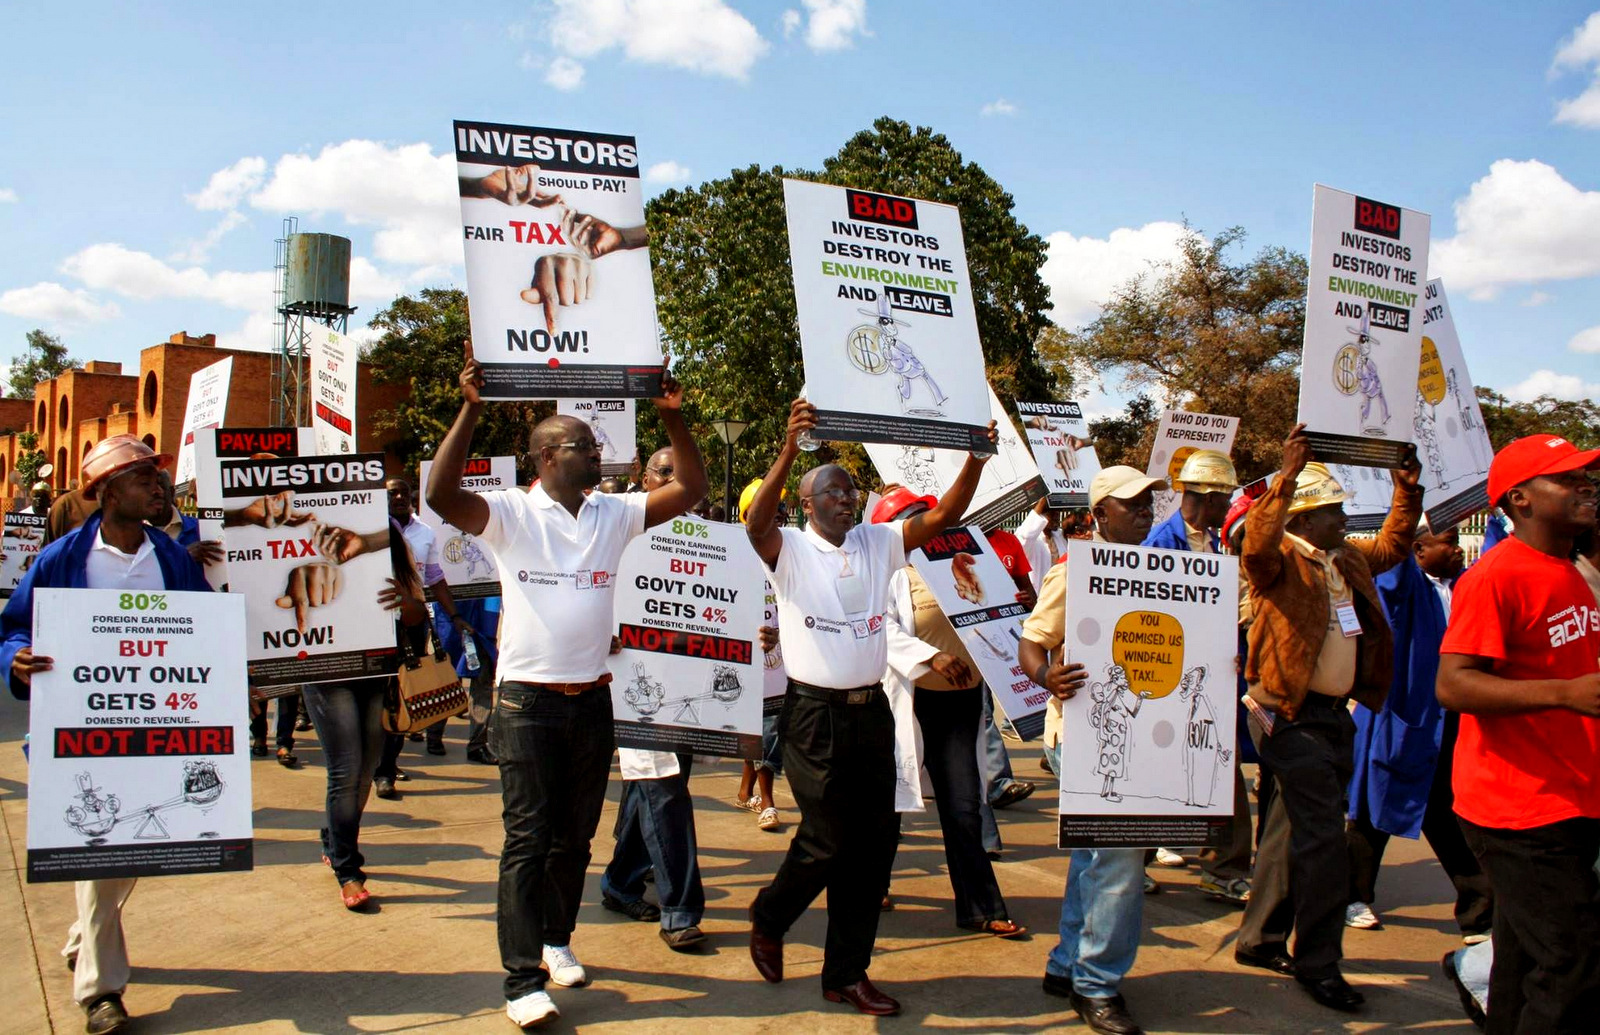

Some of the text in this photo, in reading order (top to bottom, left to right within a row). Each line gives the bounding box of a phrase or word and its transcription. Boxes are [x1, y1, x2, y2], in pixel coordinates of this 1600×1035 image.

[457, 127, 638, 169] INVESTORS
[538, 176, 627, 193] SHOULD PAY!
[852, 193, 914, 223] BAD
[1360, 201, 1399, 233] BAD
[464, 220, 567, 246] FAIR TAX
[831, 220, 940, 251] INVESTORS
[1341, 231, 1412, 262] INVESTORS
[822, 240, 954, 274] DESTROY THE
[821, 261, 960, 295] ENVIRONMENT
[1332, 252, 1417, 286] DESTROY THE
[837, 284, 952, 314] AND LEAVE.
[1327, 276, 1418, 308] ENVIRONMENT
[1334, 301, 1408, 329] AND LEAVE.
[506, 328, 590, 354] NOW!
[574, 402, 625, 411] AND LEAVE.
[1018, 401, 1081, 415] INVESTORS
[1171, 413, 1230, 429] WHO DO YOU
[220, 432, 292, 451] PAY-UP!
[1030, 436, 1064, 447] FAIR TAX
[1165, 428, 1226, 444] REPRESENT?
[222, 459, 385, 489] INVESTORS
[463, 460, 490, 473] AD
[1054, 478, 1085, 490] NOW!
[293, 492, 373, 508] SHOULD PAY!
[5, 514, 47, 526] INVEST
[672, 519, 709, 539] 80%
[19, 544, 39, 552] TAX
[228, 539, 318, 563] FAIR TAX
[651, 535, 727, 553] FOREIGN EARNINGS
[924, 531, 976, 554] PAY-UP!
[650, 543, 727, 562] COME FROM MINING
[670, 558, 708, 577] BUT
[1091, 547, 1220, 578] WHO DO YOU
[635, 575, 687, 596] GOVT
[692, 585, 739, 604] ONLY
[1089, 576, 1221, 605] REPRESENT?
[119, 593, 168, 611] 80%
[644, 598, 727, 624] GETS 4%
[92, 615, 193, 625] FOREIGN EARNINGS
[954, 612, 990, 627] CLEAN-UP!
[998, 606, 1012, 617] GET
[1139, 614, 1160, 627] YOU
[92, 626, 194, 635] COME FROM MINING
[642, 617, 729, 636] DOMESTIC REVENUE...
[263, 625, 334, 650] NOW!
[621, 625, 751, 663] NOT FAIR!
[1115, 630, 1182, 647] PROMISED US
[119, 640, 168, 657] BUT
[1124, 650, 1173, 665] WINDFALL
[73, 665, 211, 684] GOVT ONLY
[1011, 679, 1041, 695] RESPO
[87, 692, 198, 711] GETS 4%
[1023, 690, 1052, 708] INVESTO
[85, 717, 140, 725] DOMESTIC
[57, 728, 232, 756] NOT FAIR!
